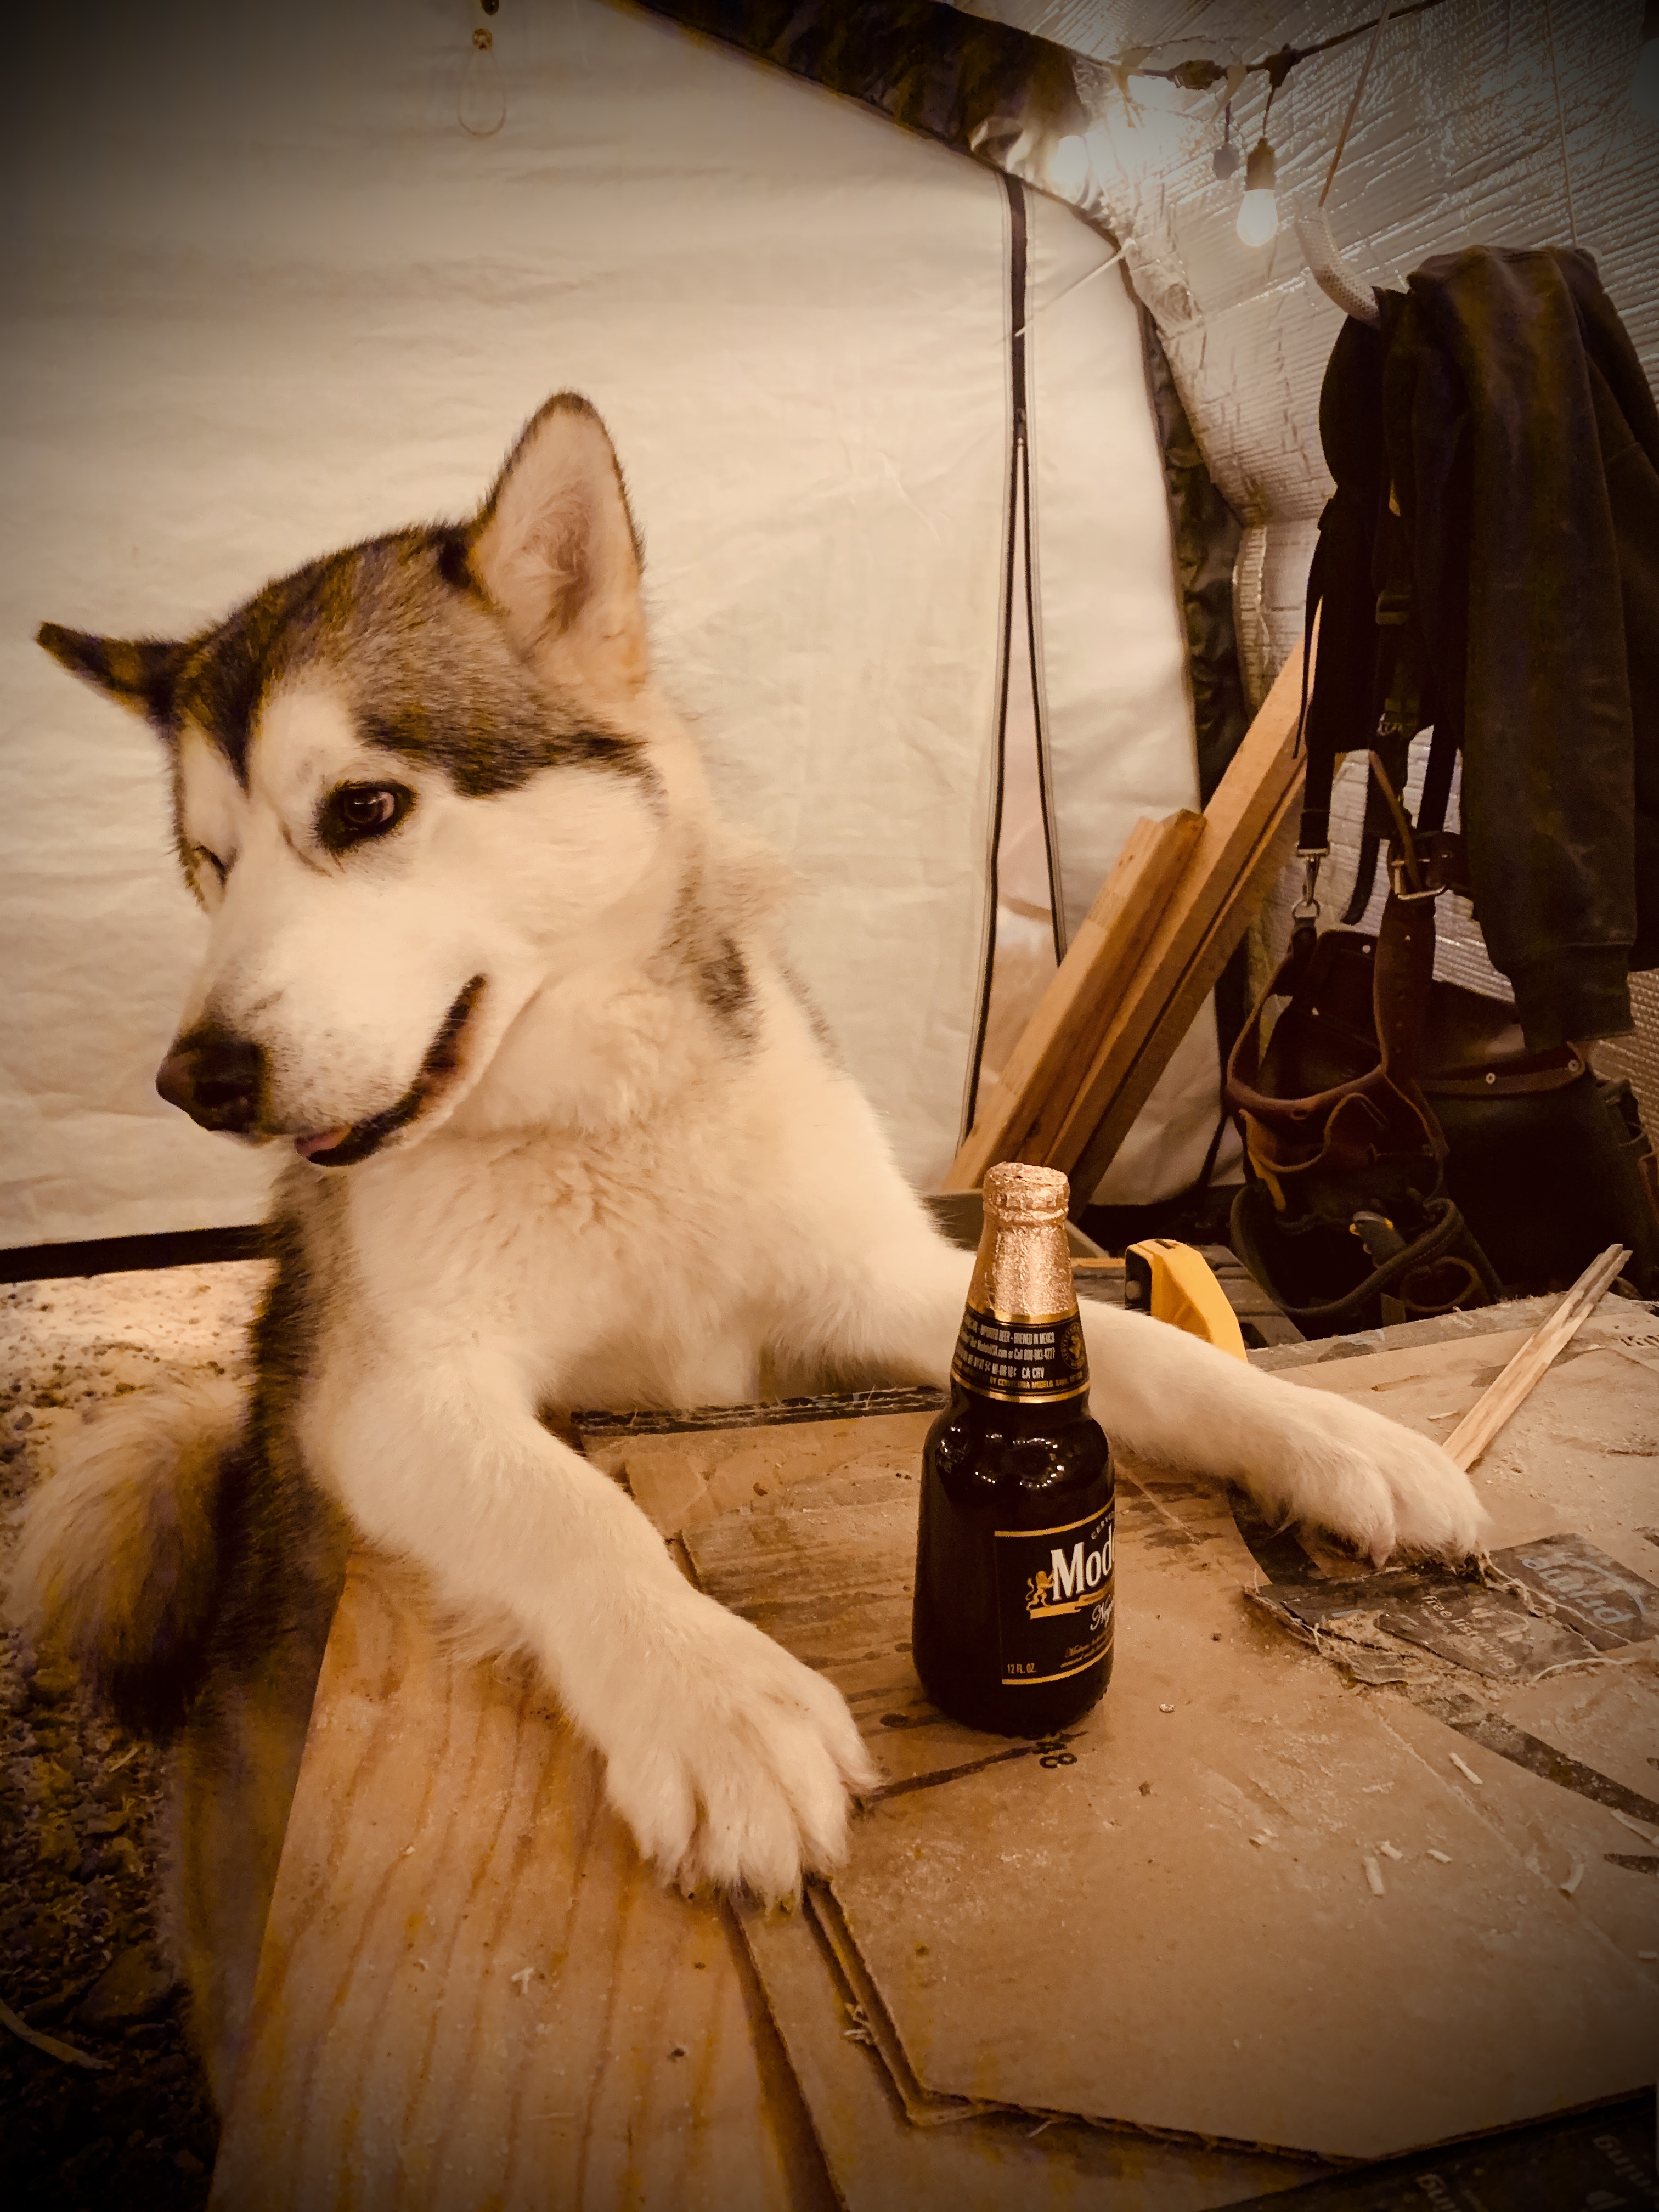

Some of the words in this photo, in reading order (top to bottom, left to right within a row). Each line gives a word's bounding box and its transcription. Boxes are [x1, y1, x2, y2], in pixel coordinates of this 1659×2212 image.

[998, 1330, 1011, 1342] BEER
[1014, 1332, 1032, 1345] BREWED
[1034, 1333, 1039, 1345] IN
[1039, 1331, 1055, 1344] MEXICO
[1022, 1367, 1030, 1379] CA
[1032, 1367, 1045, 1379] CRV
[1522, 1558, 1637, 1624] prime
[1422, 1595, 1453, 1619] free
[1450, 1618, 1516, 1669] listening
[1007, 1664, 1015, 1674] 12
